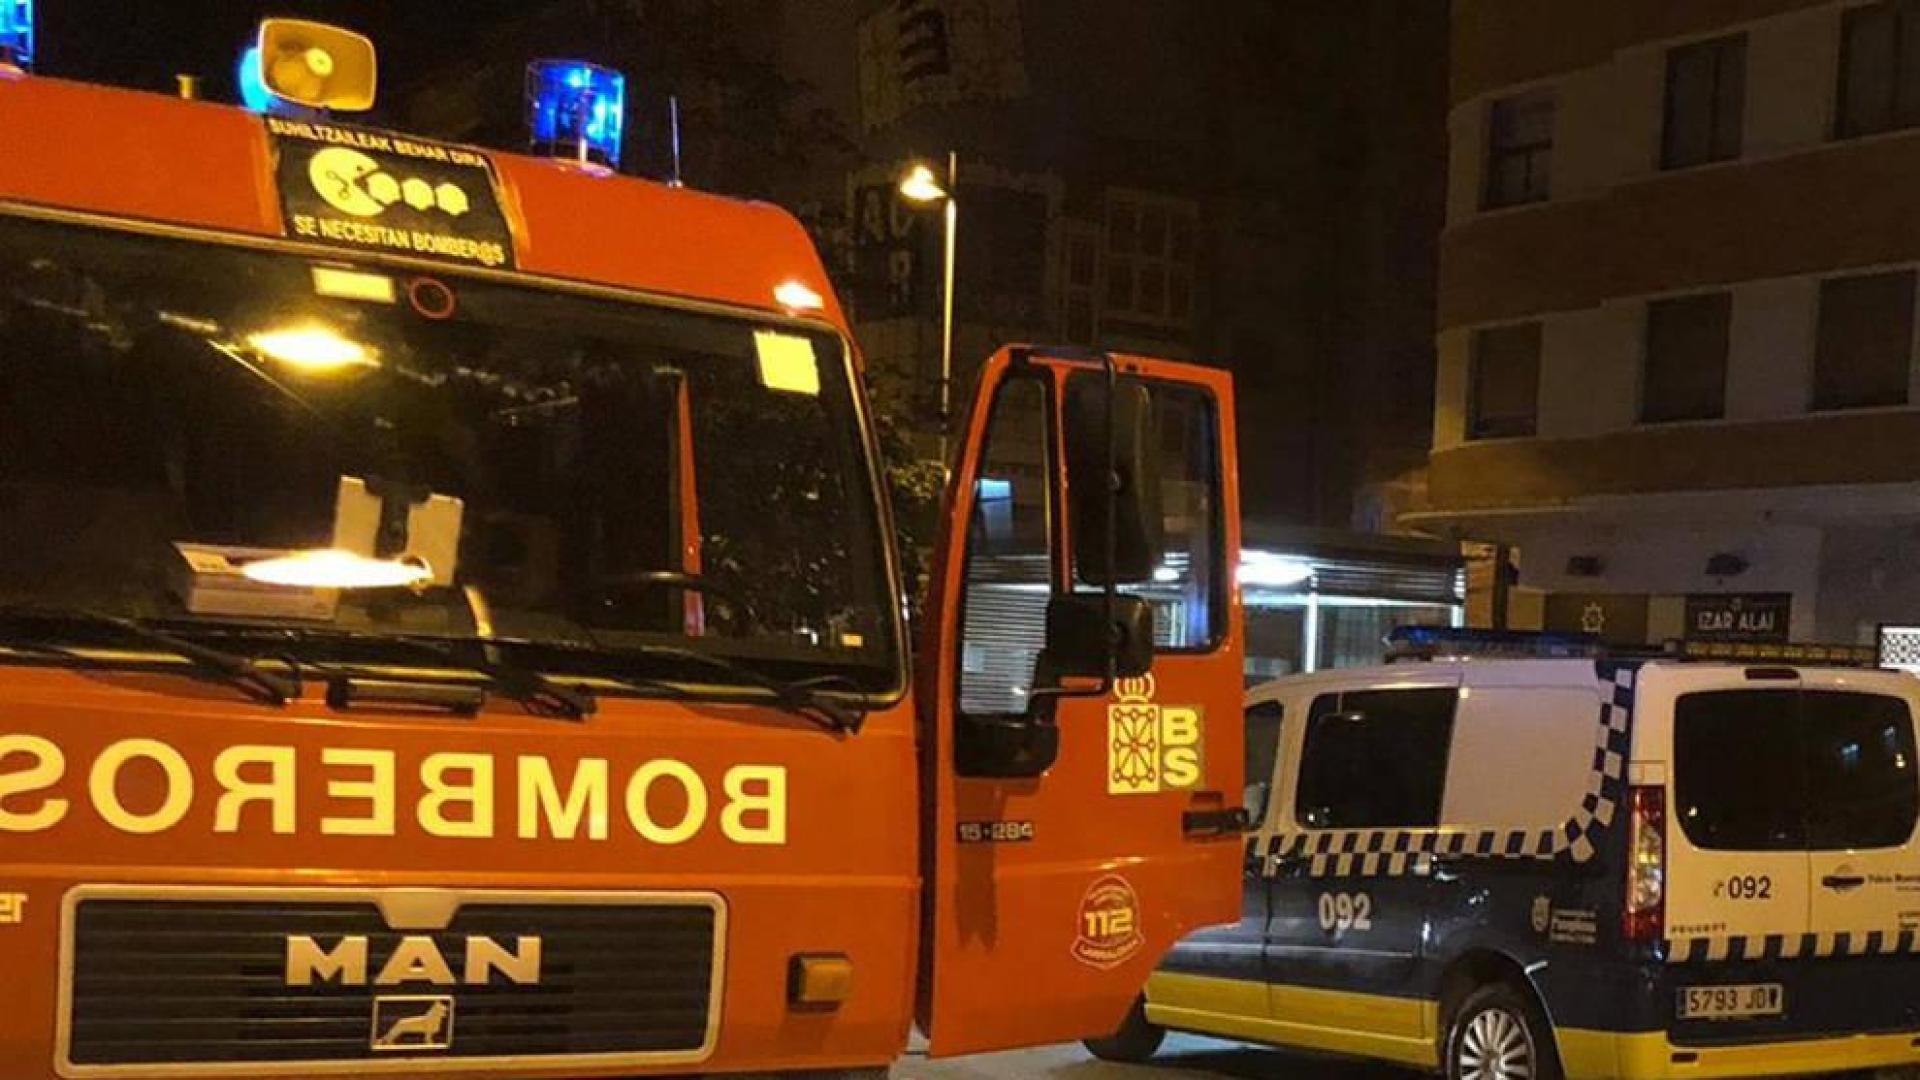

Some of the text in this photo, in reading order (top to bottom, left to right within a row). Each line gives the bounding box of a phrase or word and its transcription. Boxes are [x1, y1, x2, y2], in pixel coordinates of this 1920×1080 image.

[293, 214, 318, 237] SE
[319, 217, 410, 249] NECESITAN
[1163, 708, 1199, 745] B
[1163, 747, 1200, 786] S
[1727, 875, 1772, 899] 092
[1084, 907, 1134, 938] 112
[1318, 891, 1372, 930] 092
[286, 935, 541, 986] MAN
[1689, 990, 1738, 1012] 5793
